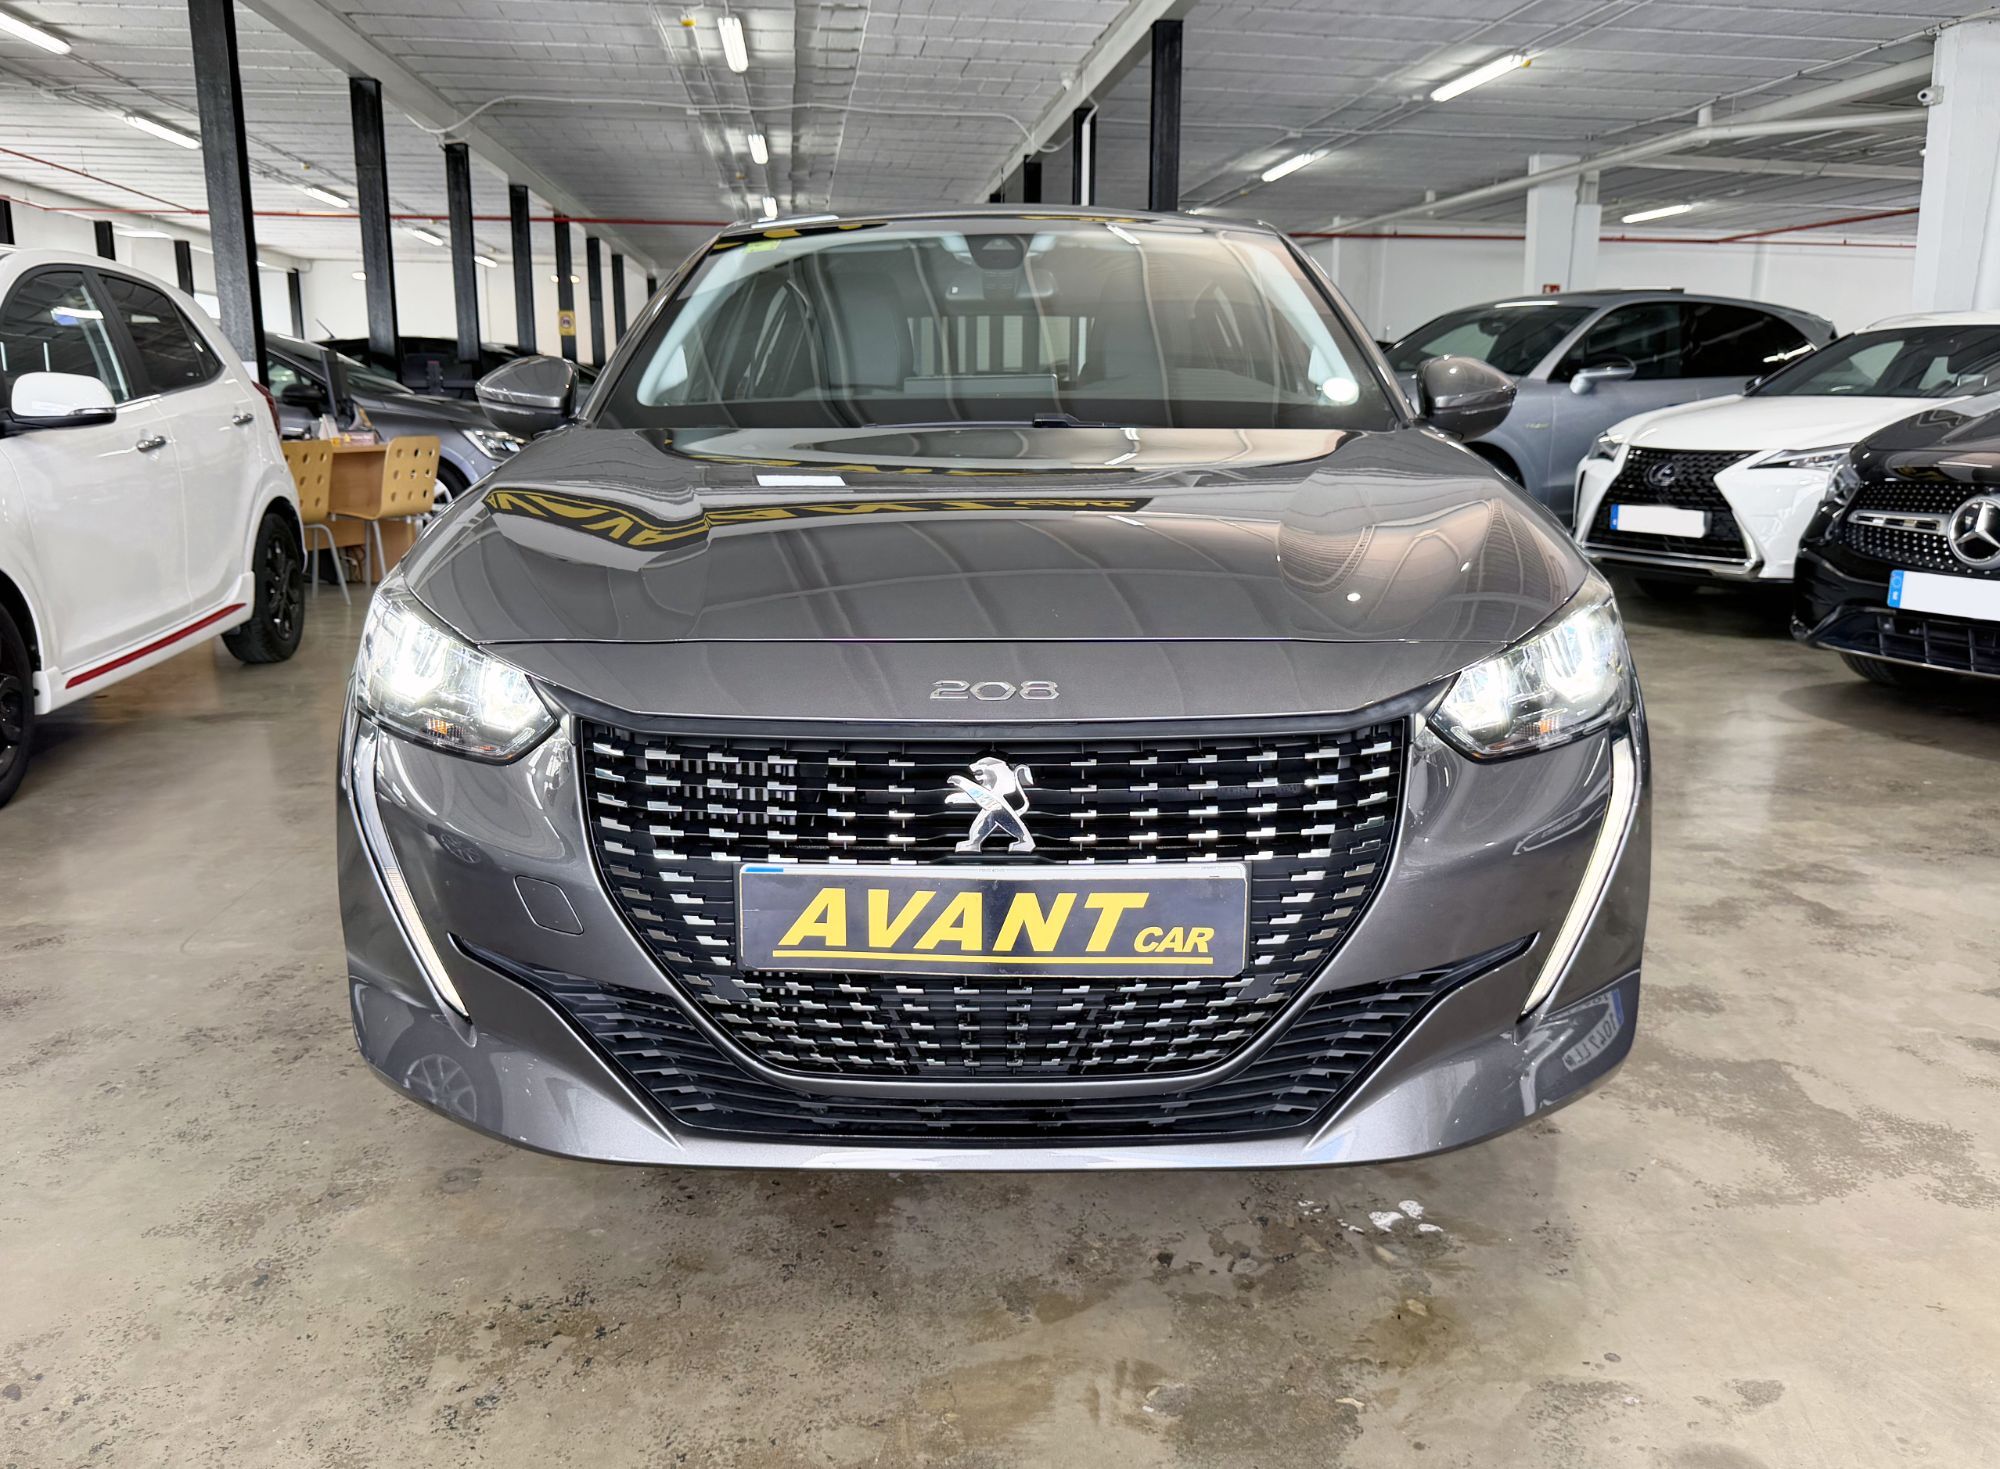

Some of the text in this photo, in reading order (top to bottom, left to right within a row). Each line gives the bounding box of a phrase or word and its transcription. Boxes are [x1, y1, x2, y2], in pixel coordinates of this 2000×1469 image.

[929, 680, 1060, 701] 208
[779, 888, 1215, 953] AVANT CAR
